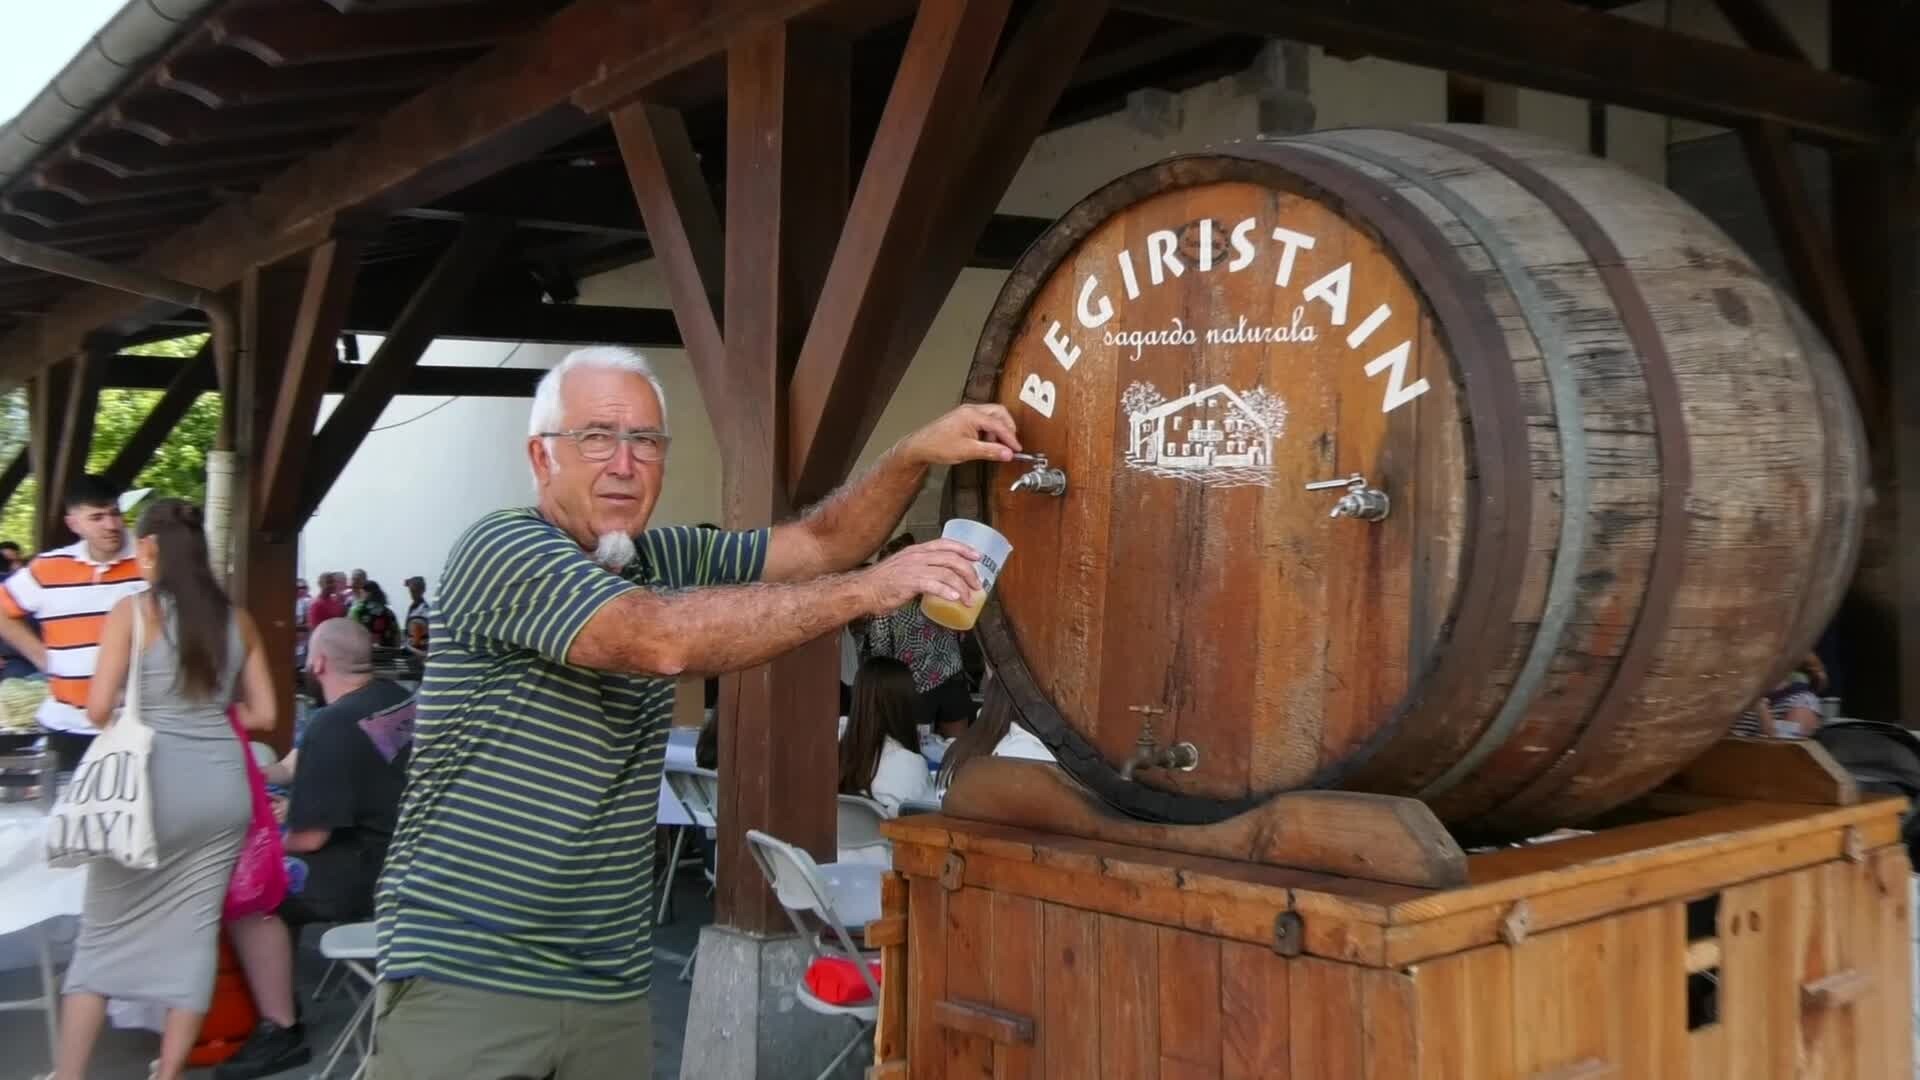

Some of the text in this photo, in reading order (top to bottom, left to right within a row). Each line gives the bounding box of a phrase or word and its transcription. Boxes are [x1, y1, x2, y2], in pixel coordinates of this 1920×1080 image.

[1018, 217, 1431, 419] BEGIRISTAIN
[1103, 306, 1319, 361] sagardo naturala
